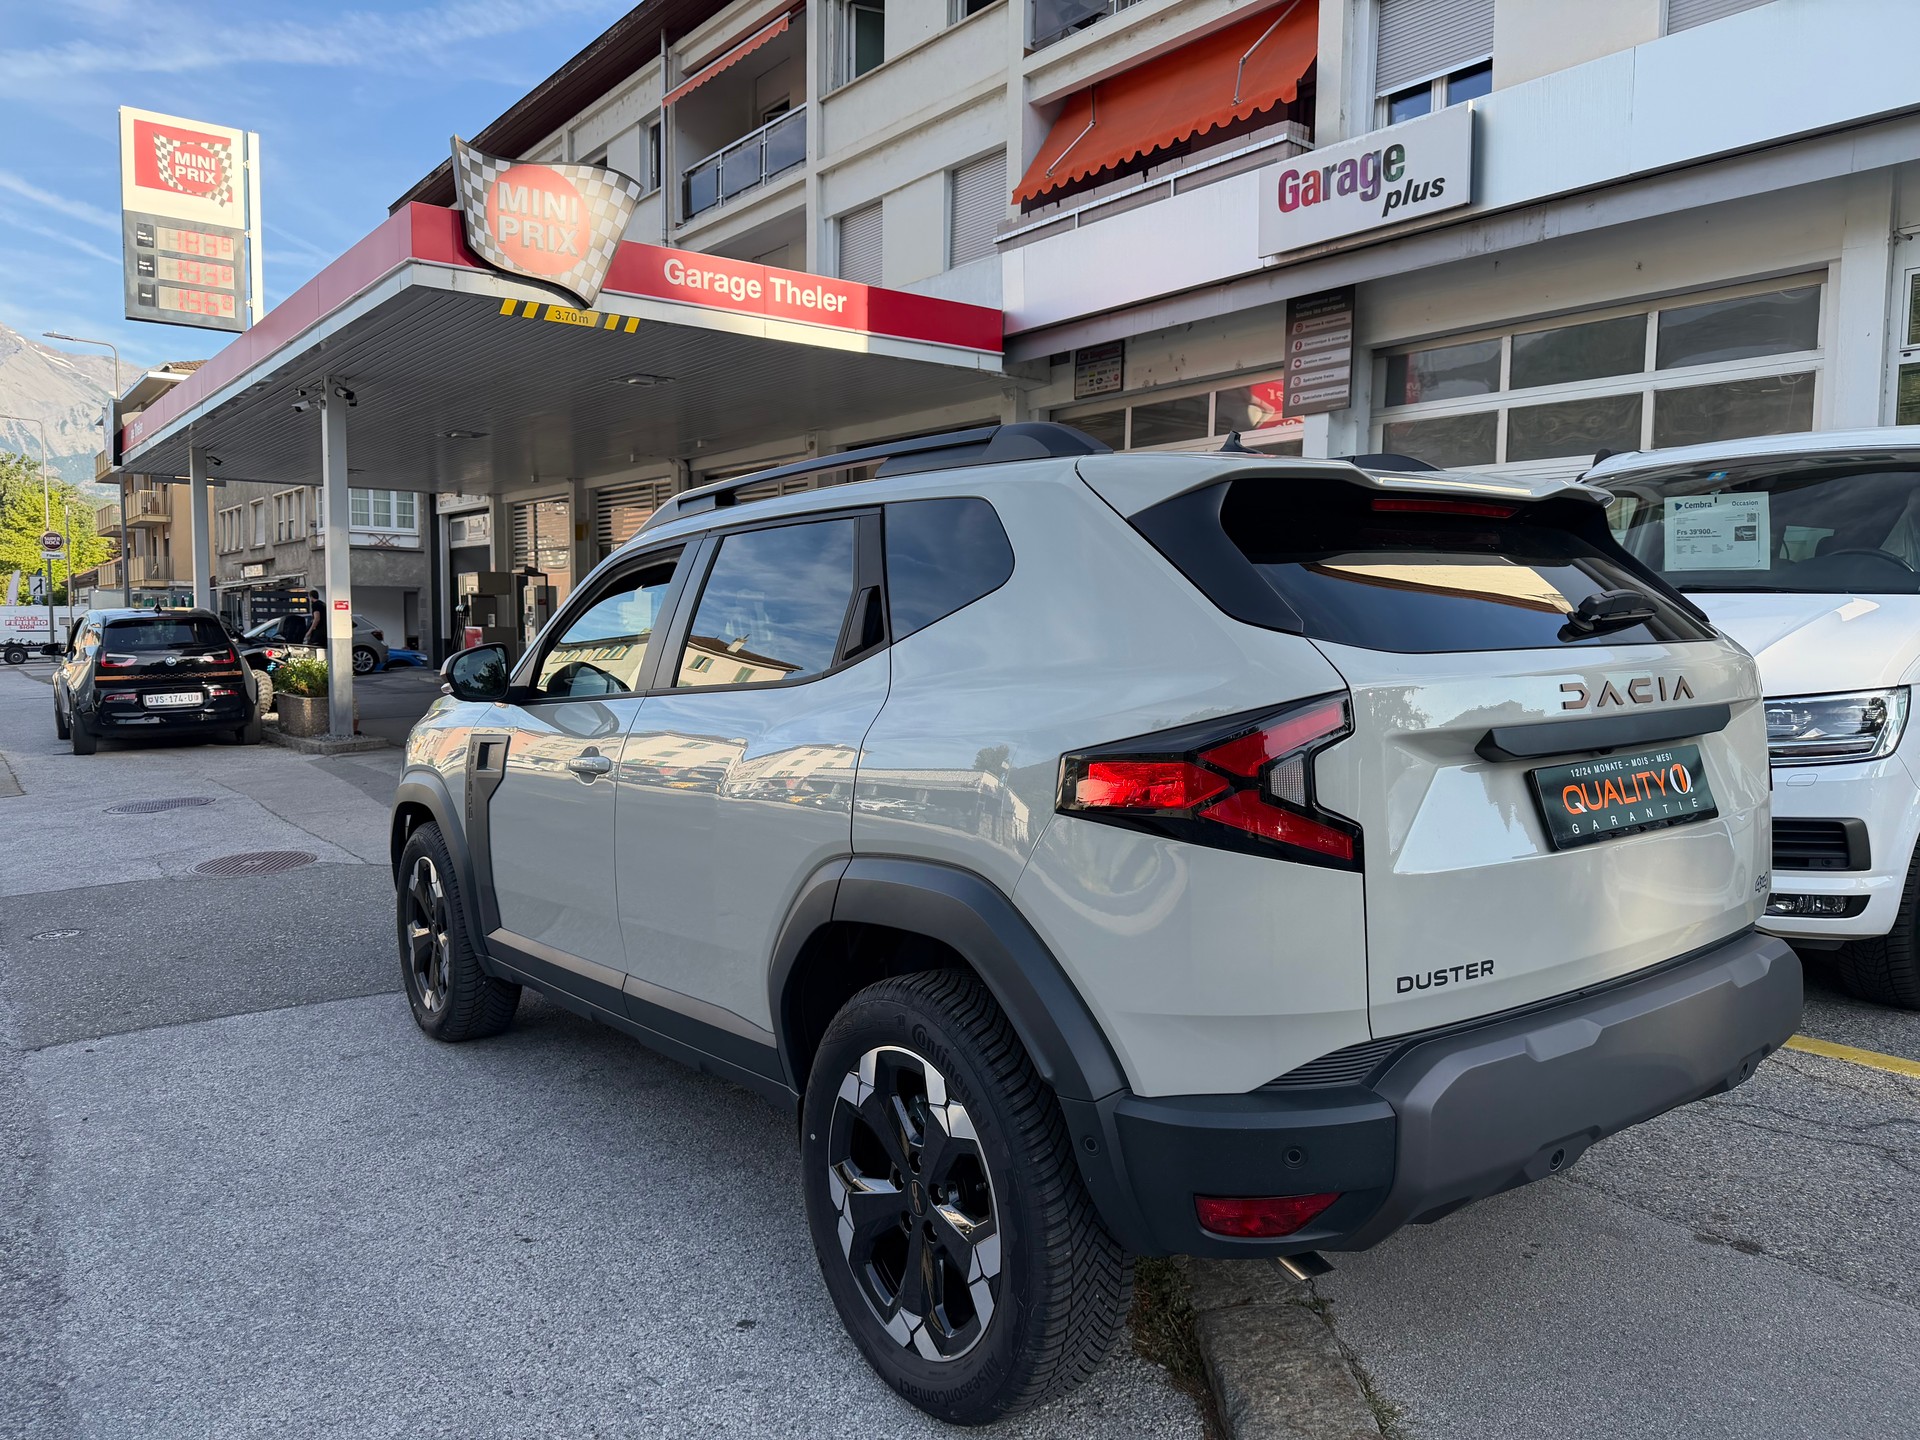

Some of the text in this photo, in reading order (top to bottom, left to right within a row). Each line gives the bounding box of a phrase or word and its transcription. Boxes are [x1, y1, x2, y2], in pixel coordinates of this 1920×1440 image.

[174, 151, 216, 170] MINI
[175, 165, 217, 184] PRIX
[1278, 143, 1405, 213] Garage
[497, 181, 579, 226] MINI
[1382, 176, 1446, 218] plus
[497, 215, 579, 257] PRIX
[663, 258, 847, 313] Garage Theler
[1684, 500, 1713, 509] Cembra
[1559, 675, 1695, 710] DACIA
[1570, 766, 1592, 778] 12/24
[1594, 760, 1623, 775] MONATE
[1630, 756, 1649, 768] MOIS
[1656, 752, 1673, 763] MESI
[1571, 798, 1698, 834] GARANTIE
[1397, 959, 1494, 993] DUSTER
[912, 1022, 991, 1132] Continental
